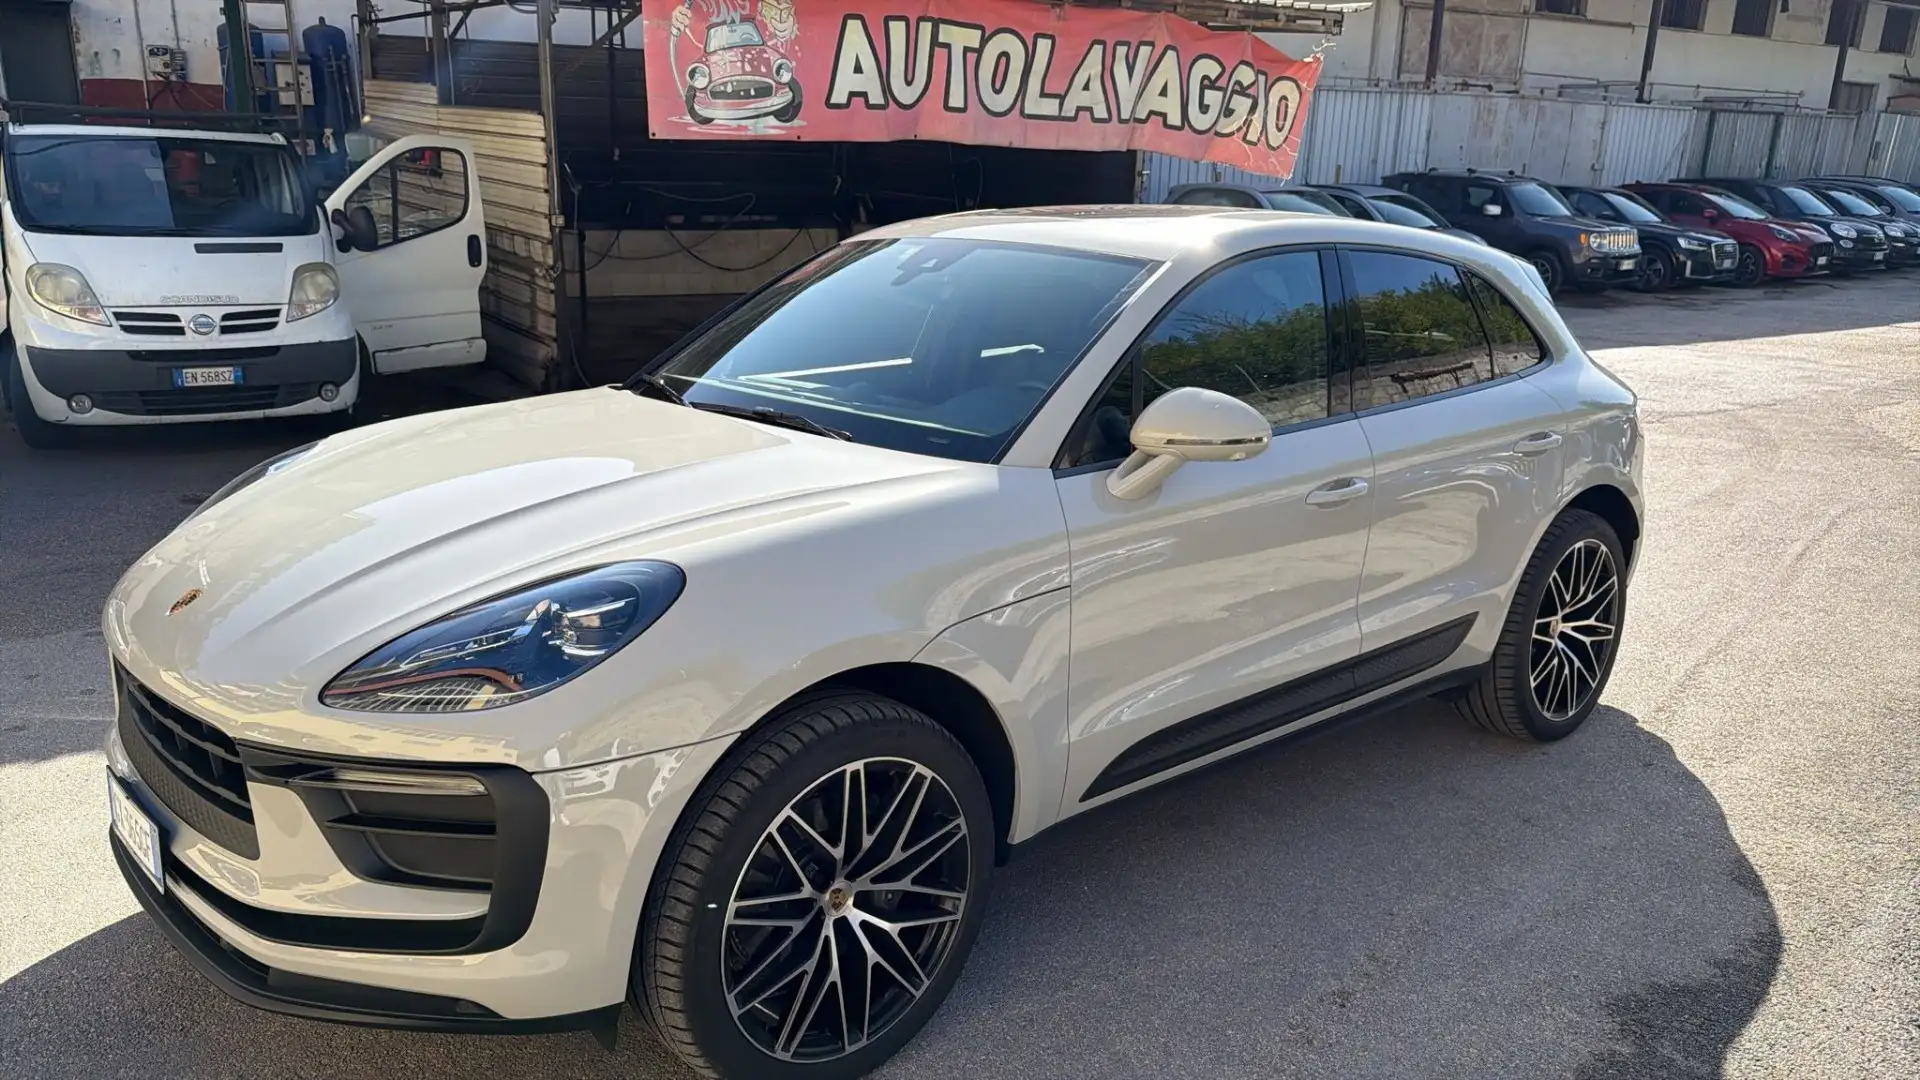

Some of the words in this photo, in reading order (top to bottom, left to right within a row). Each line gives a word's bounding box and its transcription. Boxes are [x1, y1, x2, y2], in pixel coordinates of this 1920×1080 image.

[825, 14, 1302, 151] AUTOLAVAGGIO
[184, 371, 198, 383] EN
[200, 370, 233, 383] 568SZ
